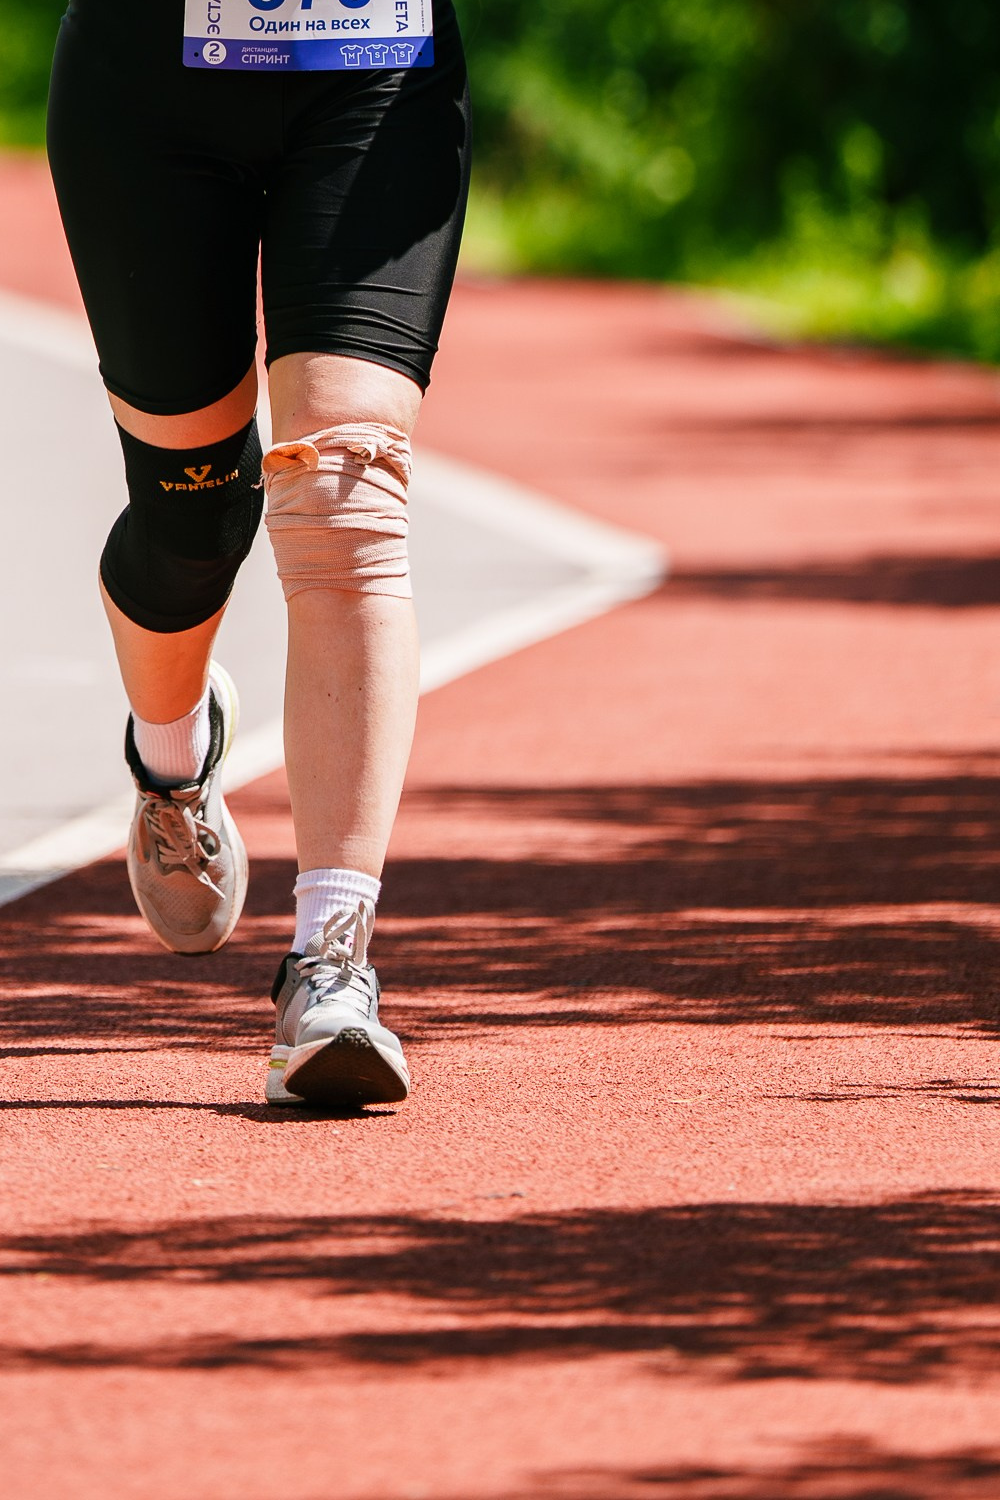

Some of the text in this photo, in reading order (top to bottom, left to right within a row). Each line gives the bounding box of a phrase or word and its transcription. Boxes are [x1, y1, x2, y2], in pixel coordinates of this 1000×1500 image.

[249, 16, 370, 34] Один на всех
[208, 42, 220, 57] 2
[241, 54, 290, 64] СПРИНТ
[159, 468, 239, 492] VANTELIN
